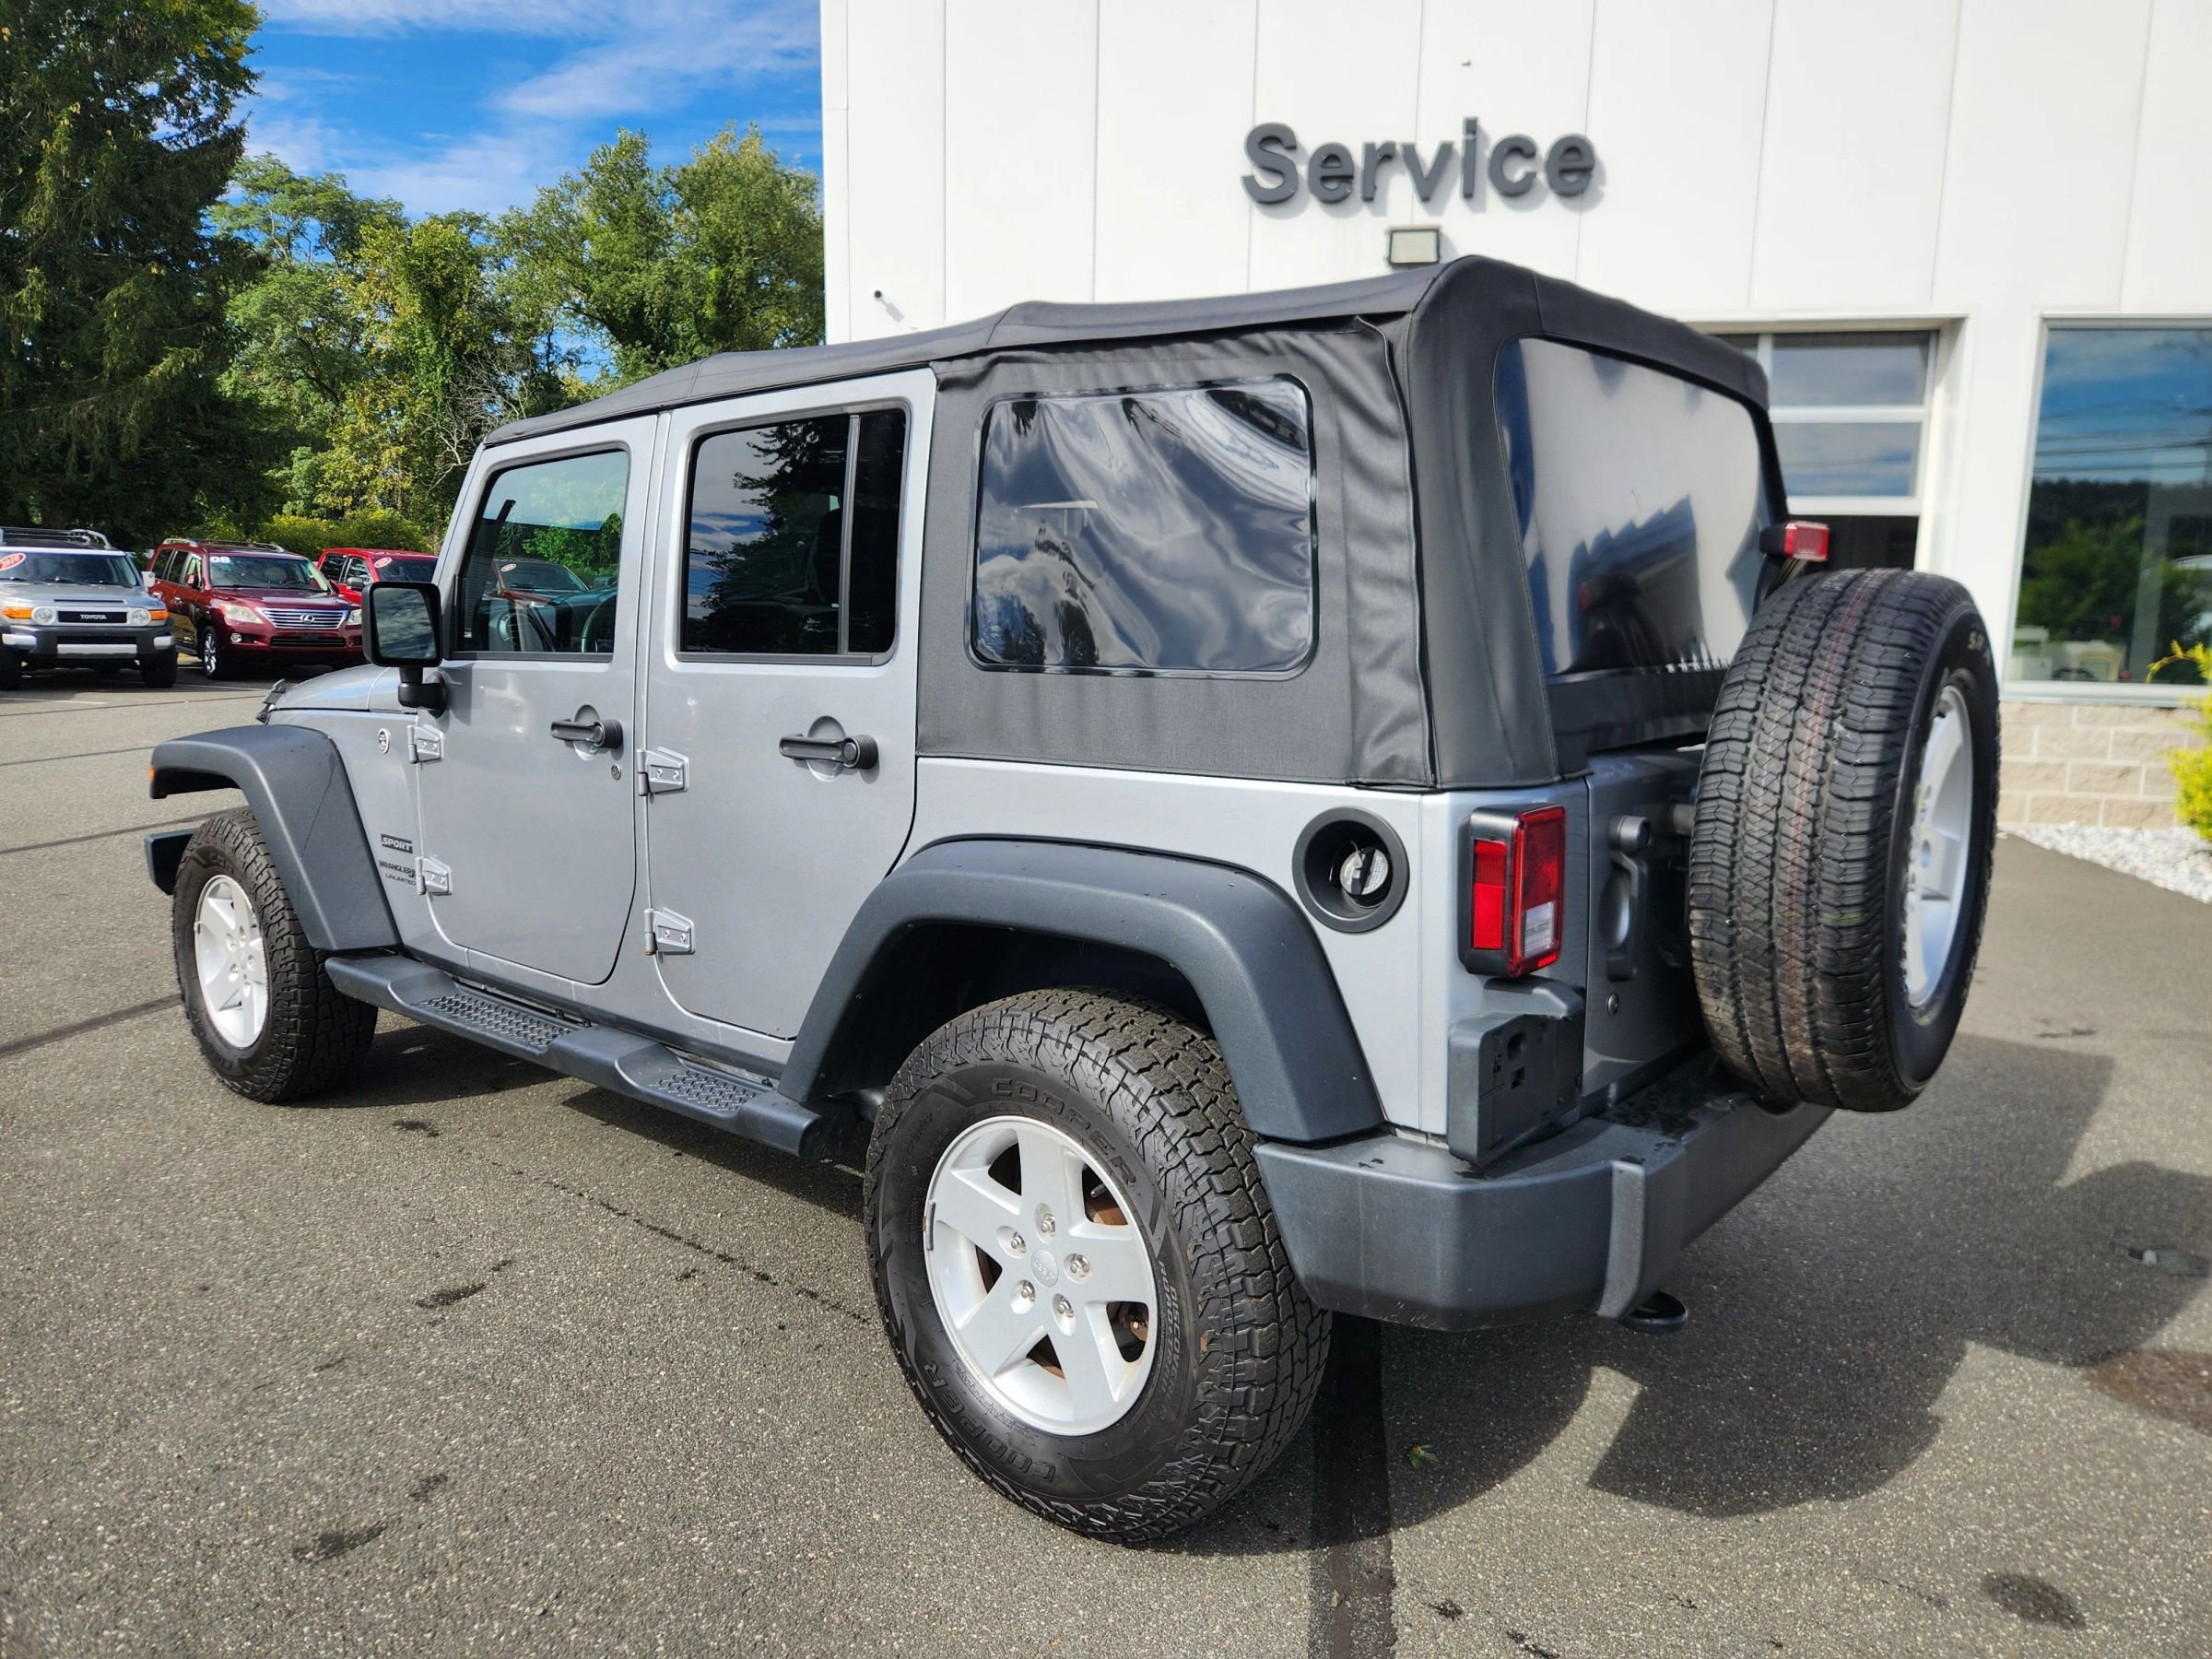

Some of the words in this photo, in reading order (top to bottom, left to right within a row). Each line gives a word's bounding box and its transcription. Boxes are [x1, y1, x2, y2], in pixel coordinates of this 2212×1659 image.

[1241, 117, 1594, 204] Service
[382, 837, 413, 851] SPORT
[991, 1077, 1136, 1185] COOPER
[924, 1360, 1056, 1482] COOPER
